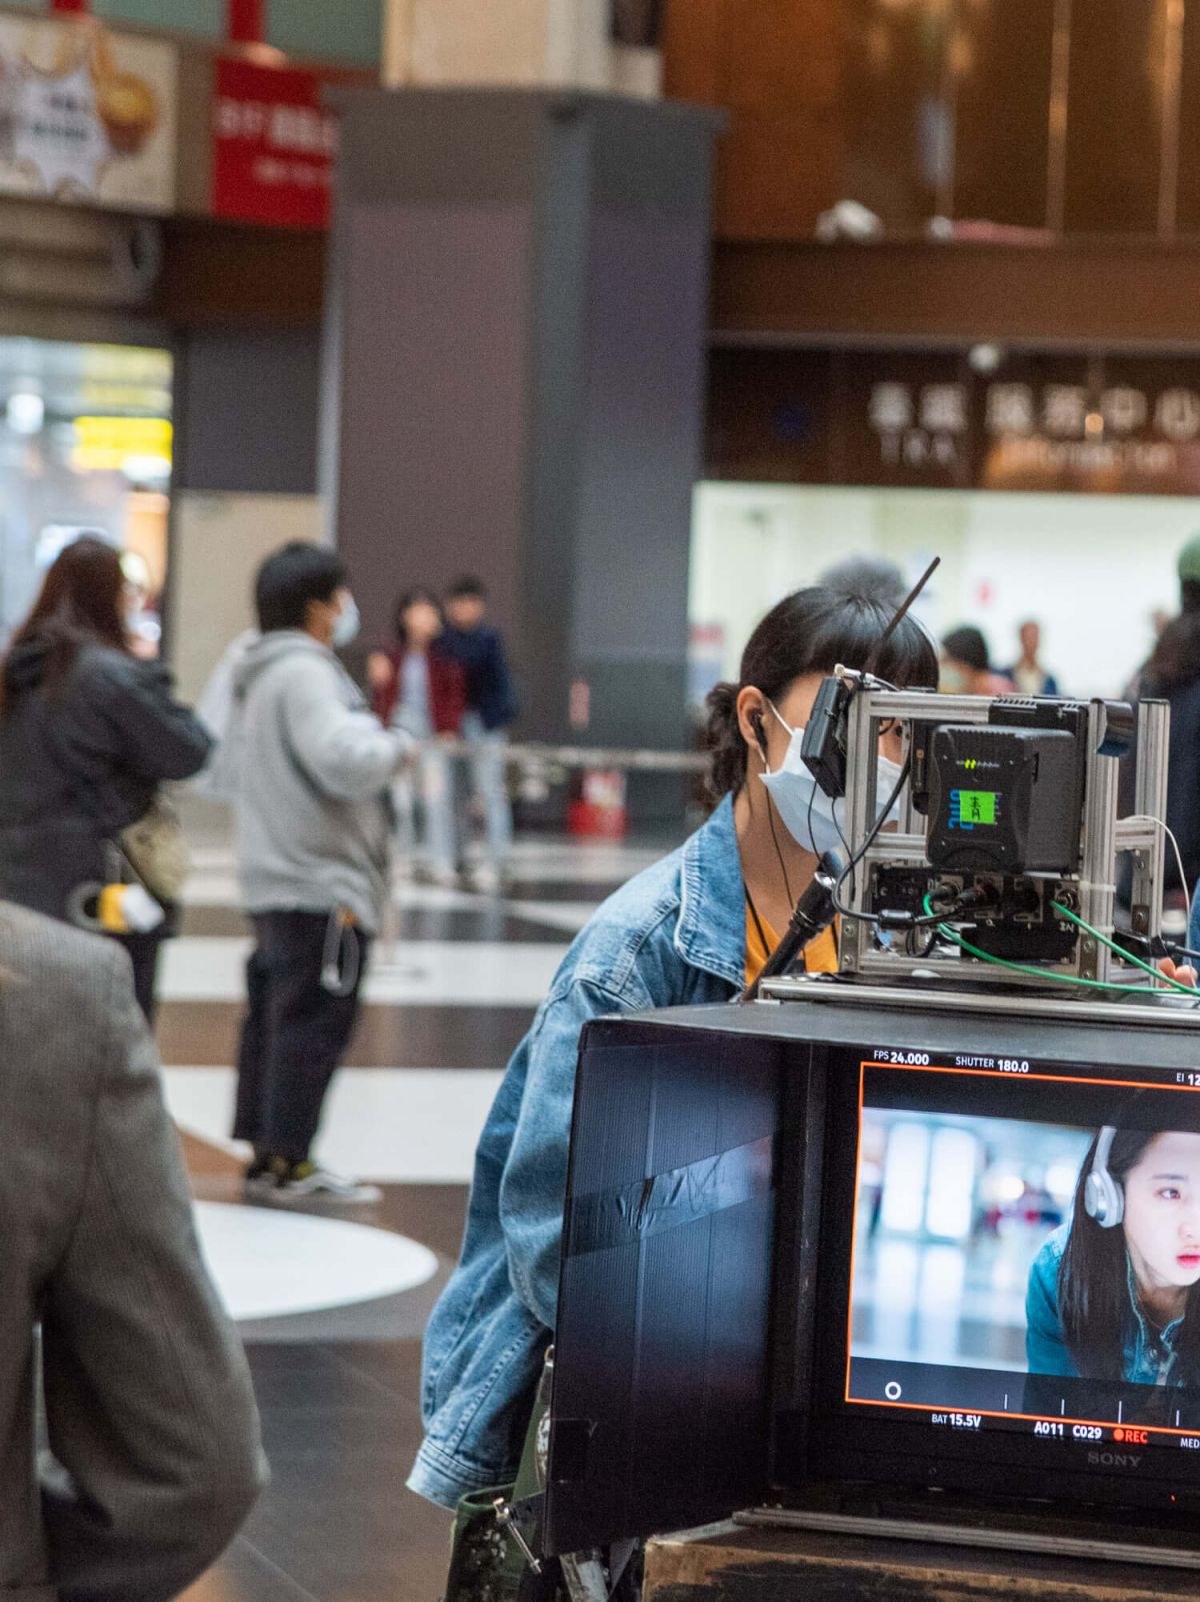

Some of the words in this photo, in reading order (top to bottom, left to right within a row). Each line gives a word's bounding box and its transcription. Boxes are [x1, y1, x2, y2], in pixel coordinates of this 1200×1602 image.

[874, 1050, 889, 1060] FPS
[890, 1051, 929, 1066] 24.000
[955, 1056, 994, 1068] SHUTTER
[997, 1059, 1029, 1073] 180.0
[931, 1414, 948, 1425] BAT
[949, 1413, 981, 1428] 15.5V
[1034, 1421, 1064, 1436] A011
[1072, 1425, 1102, 1439] C029
[1125, 1430, 1148, 1443] REC
[1087, 1451, 1141, 1467] SONY
